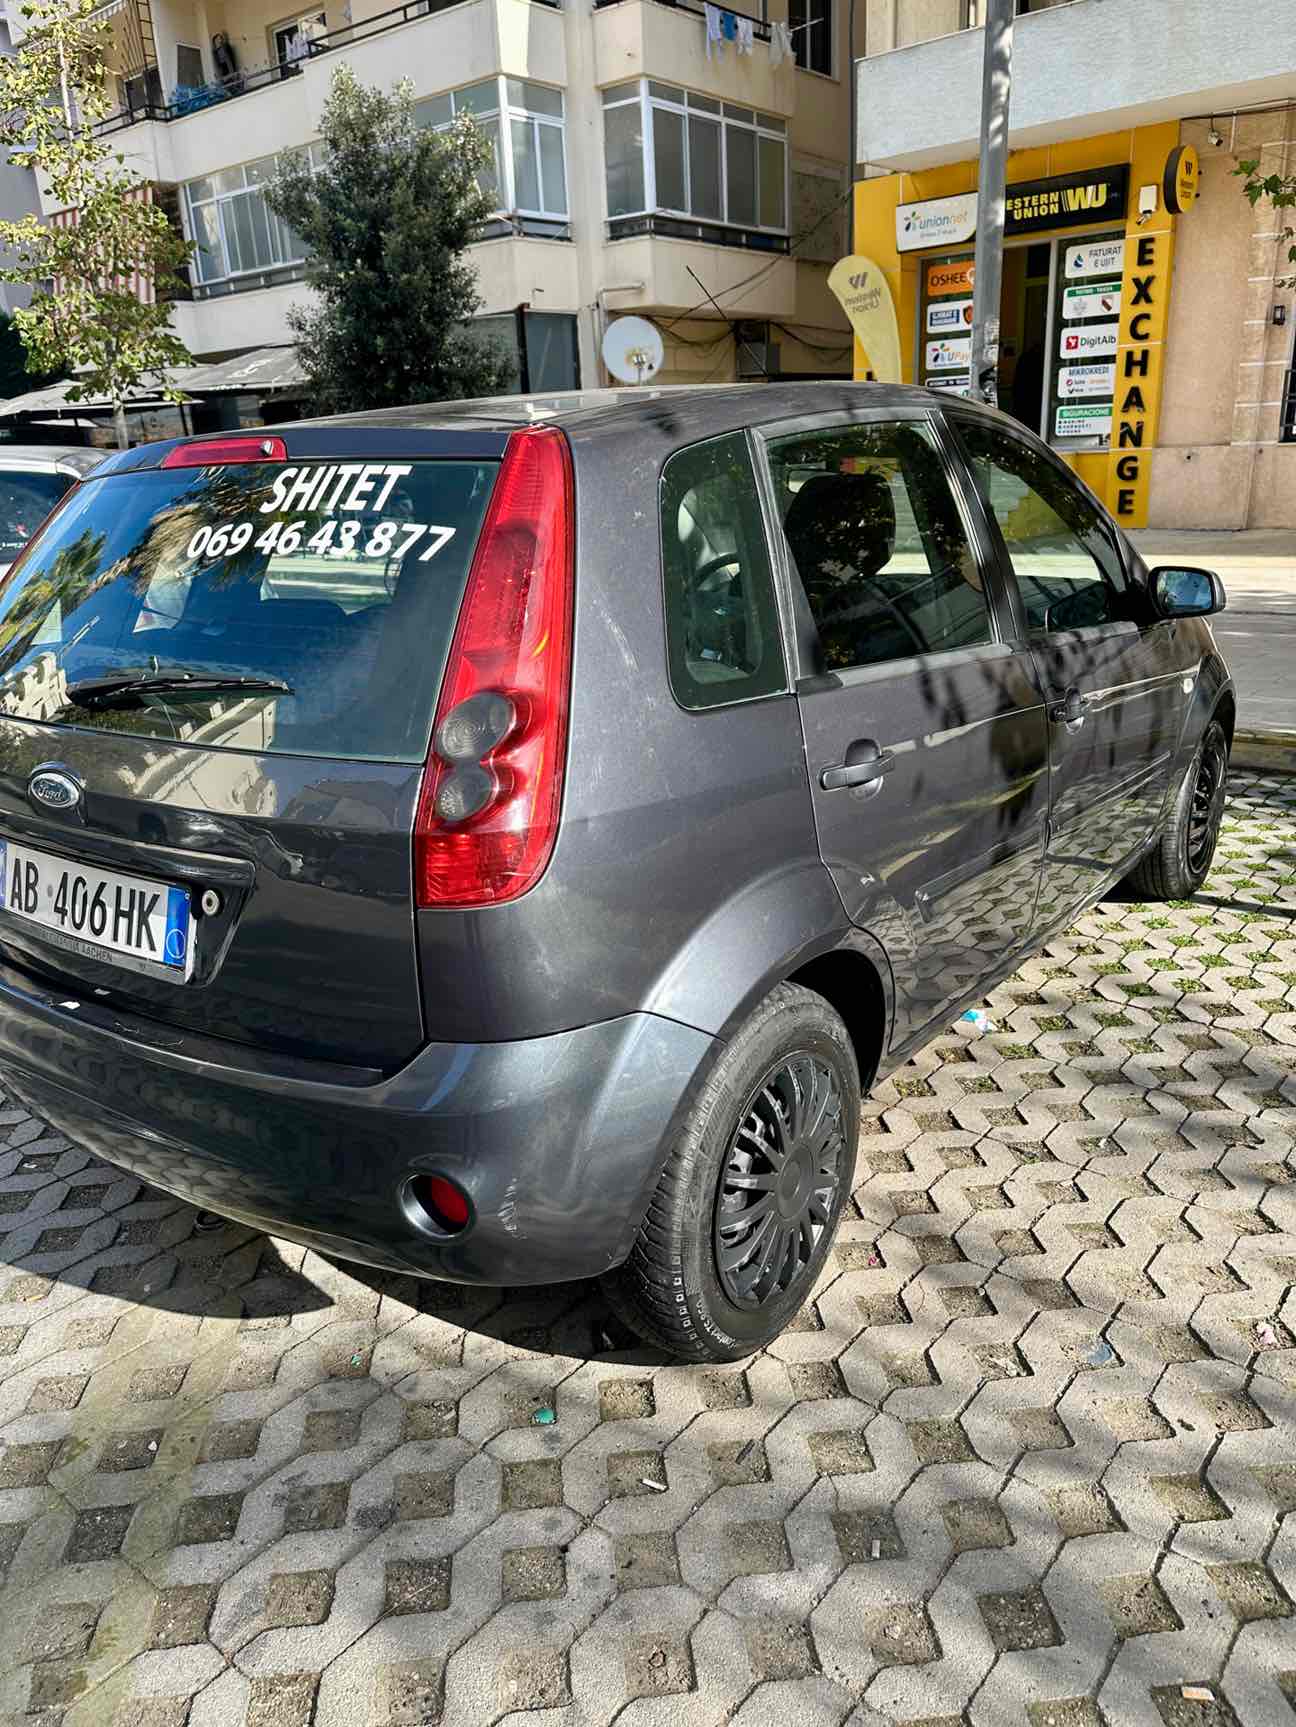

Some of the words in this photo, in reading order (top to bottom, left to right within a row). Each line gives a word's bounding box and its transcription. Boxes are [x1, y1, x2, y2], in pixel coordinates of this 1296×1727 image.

[1006, 191, 1059, 211] ESTERN
[1066, 184, 1108, 211] WU
[919, 210, 968, 230] unionnet
[1013, 205, 1059, 220] UNION
[930, 271, 967, 287] OSHEE
[1080, 335, 1116, 348] DigitAlb
[1117, 237, 1155, 515] EXCHANGE
[259, 464, 413, 514] SHITET
[187, 521, 254, 558] 069
[254, 520, 306, 555] 46
[307, 520, 361, 554] 43
[365, 521, 457, 561] 877
[37, 779, 63, 801] Ford
[10, 858, 40, 914] AB
[53, 871, 108, 936] 406
[113, 886, 160, 952] HK
